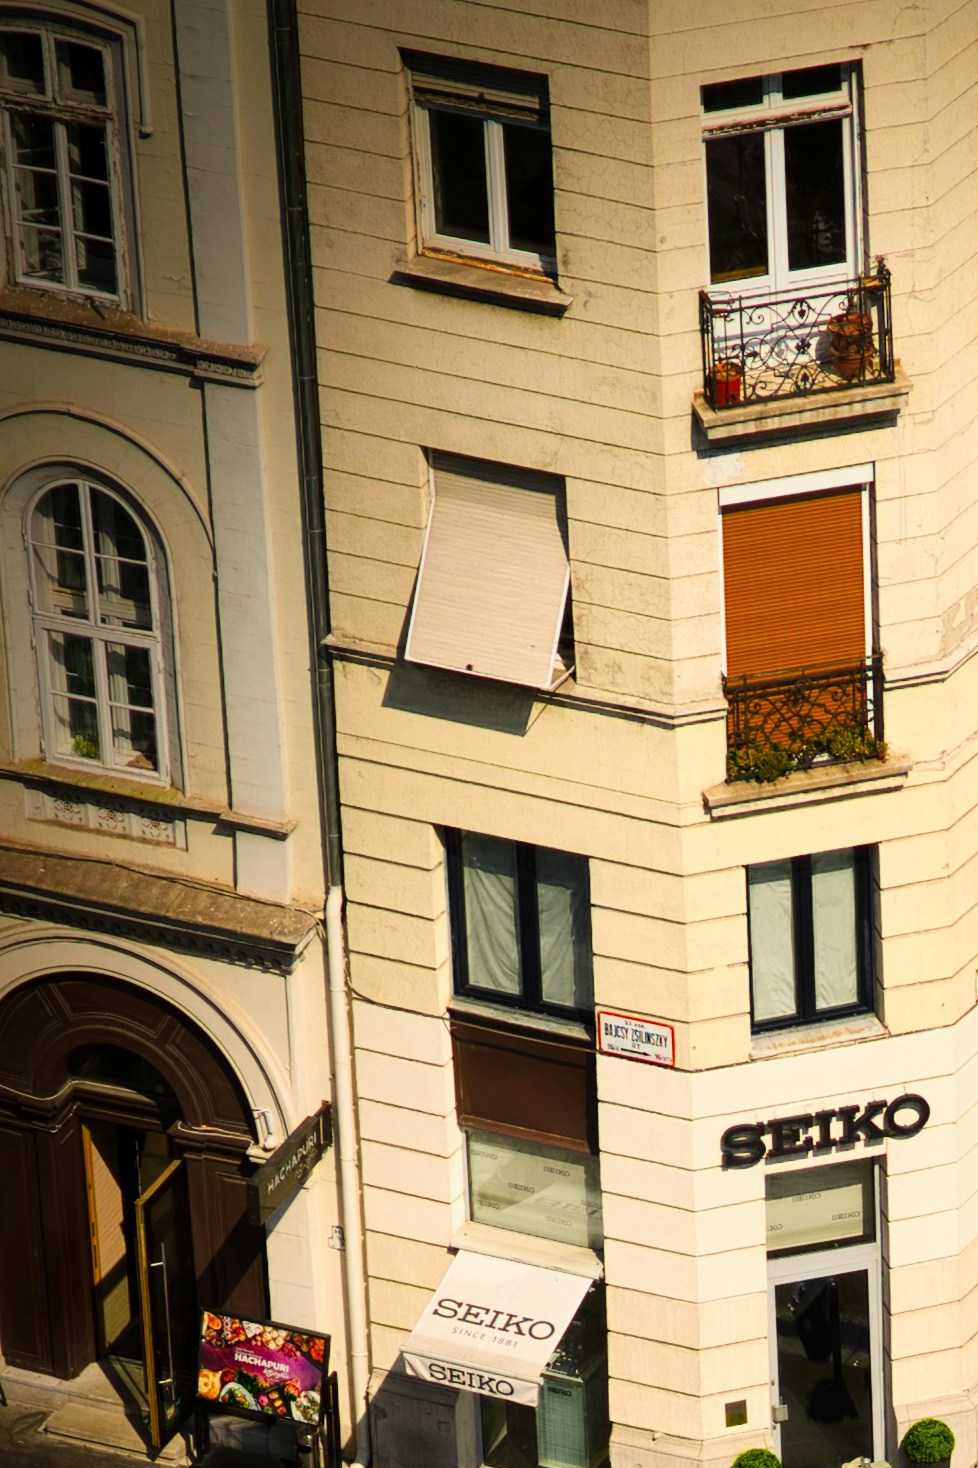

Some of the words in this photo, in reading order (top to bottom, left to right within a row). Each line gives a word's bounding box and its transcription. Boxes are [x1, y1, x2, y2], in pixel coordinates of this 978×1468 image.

[604, 1022, 628, 1040] BAJCSY
[720, 1093, 931, 1171] SEIKO
[267, 1131, 317, 1195] HACHAPURI
[832, 1210, 861, 1221] SEIKO
[433, 1298, 555, 1340] SEIKO
[452, 1326, 486, 1340] SINCE
[492, 1335, 519, 1348] 1881
[234, 1353, 290, 1372] HACHAPURI
[428, 1363, 514, 1396] SEIKO
